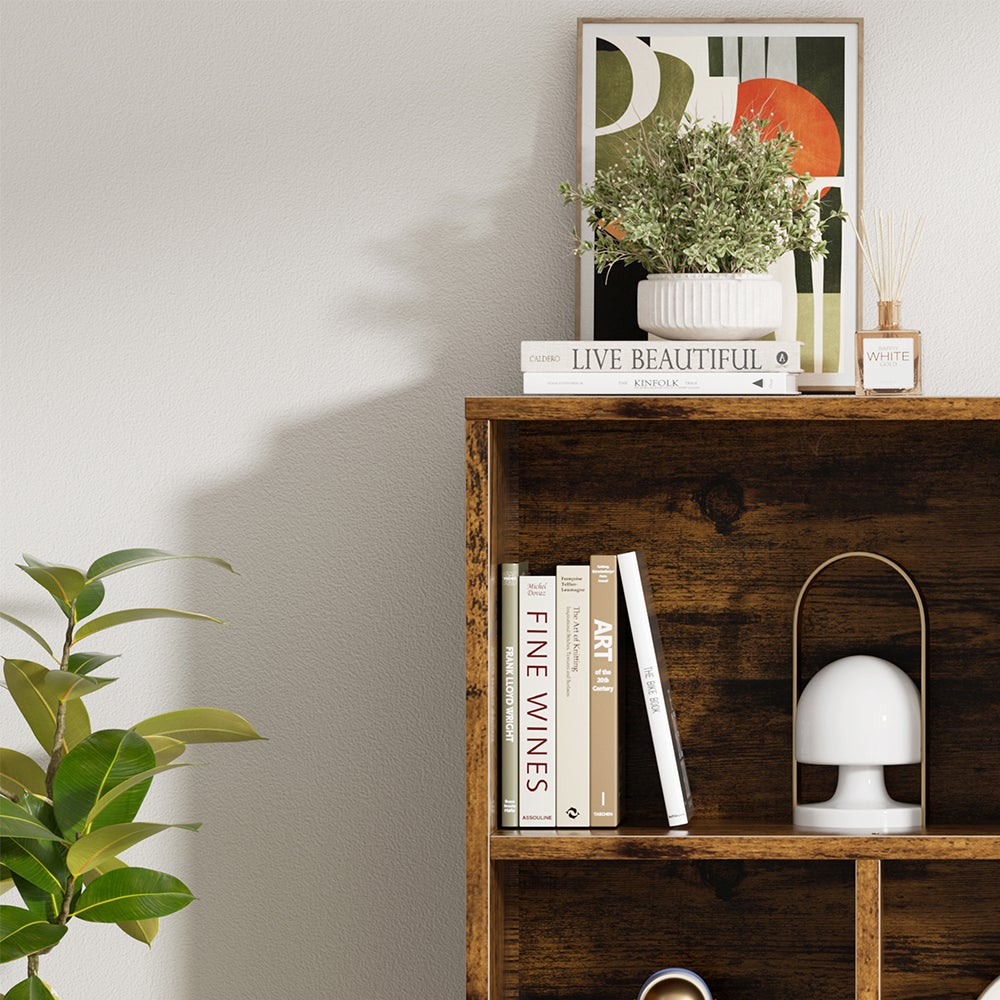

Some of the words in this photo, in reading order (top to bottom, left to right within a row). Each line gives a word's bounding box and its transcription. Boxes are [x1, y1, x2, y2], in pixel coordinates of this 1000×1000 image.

[572, 348, 622, 371] LIVE
[631, 348, 763, 371] BEAUTIFUL
[866, 351, 910, 362] WHITE
[634, 379, 679, 387] KINFOLK
[573, 621, 581, 633] Art
[526, 611, 548, 677] FINE
[594, 618, 613, 662] ART
[505, 646, 515, 675] FRANK
[644, 666, 654, 679] THE
[505, 677, 515, 706] LLOYD
[592, 685, 614, 693] Century
[647, 681, 658, 695] BIKE
[650, 695, 661, 714] BOOK
[505, 707, 515, 743] WRIGHT
[526, 691, 548, 792] WINES
